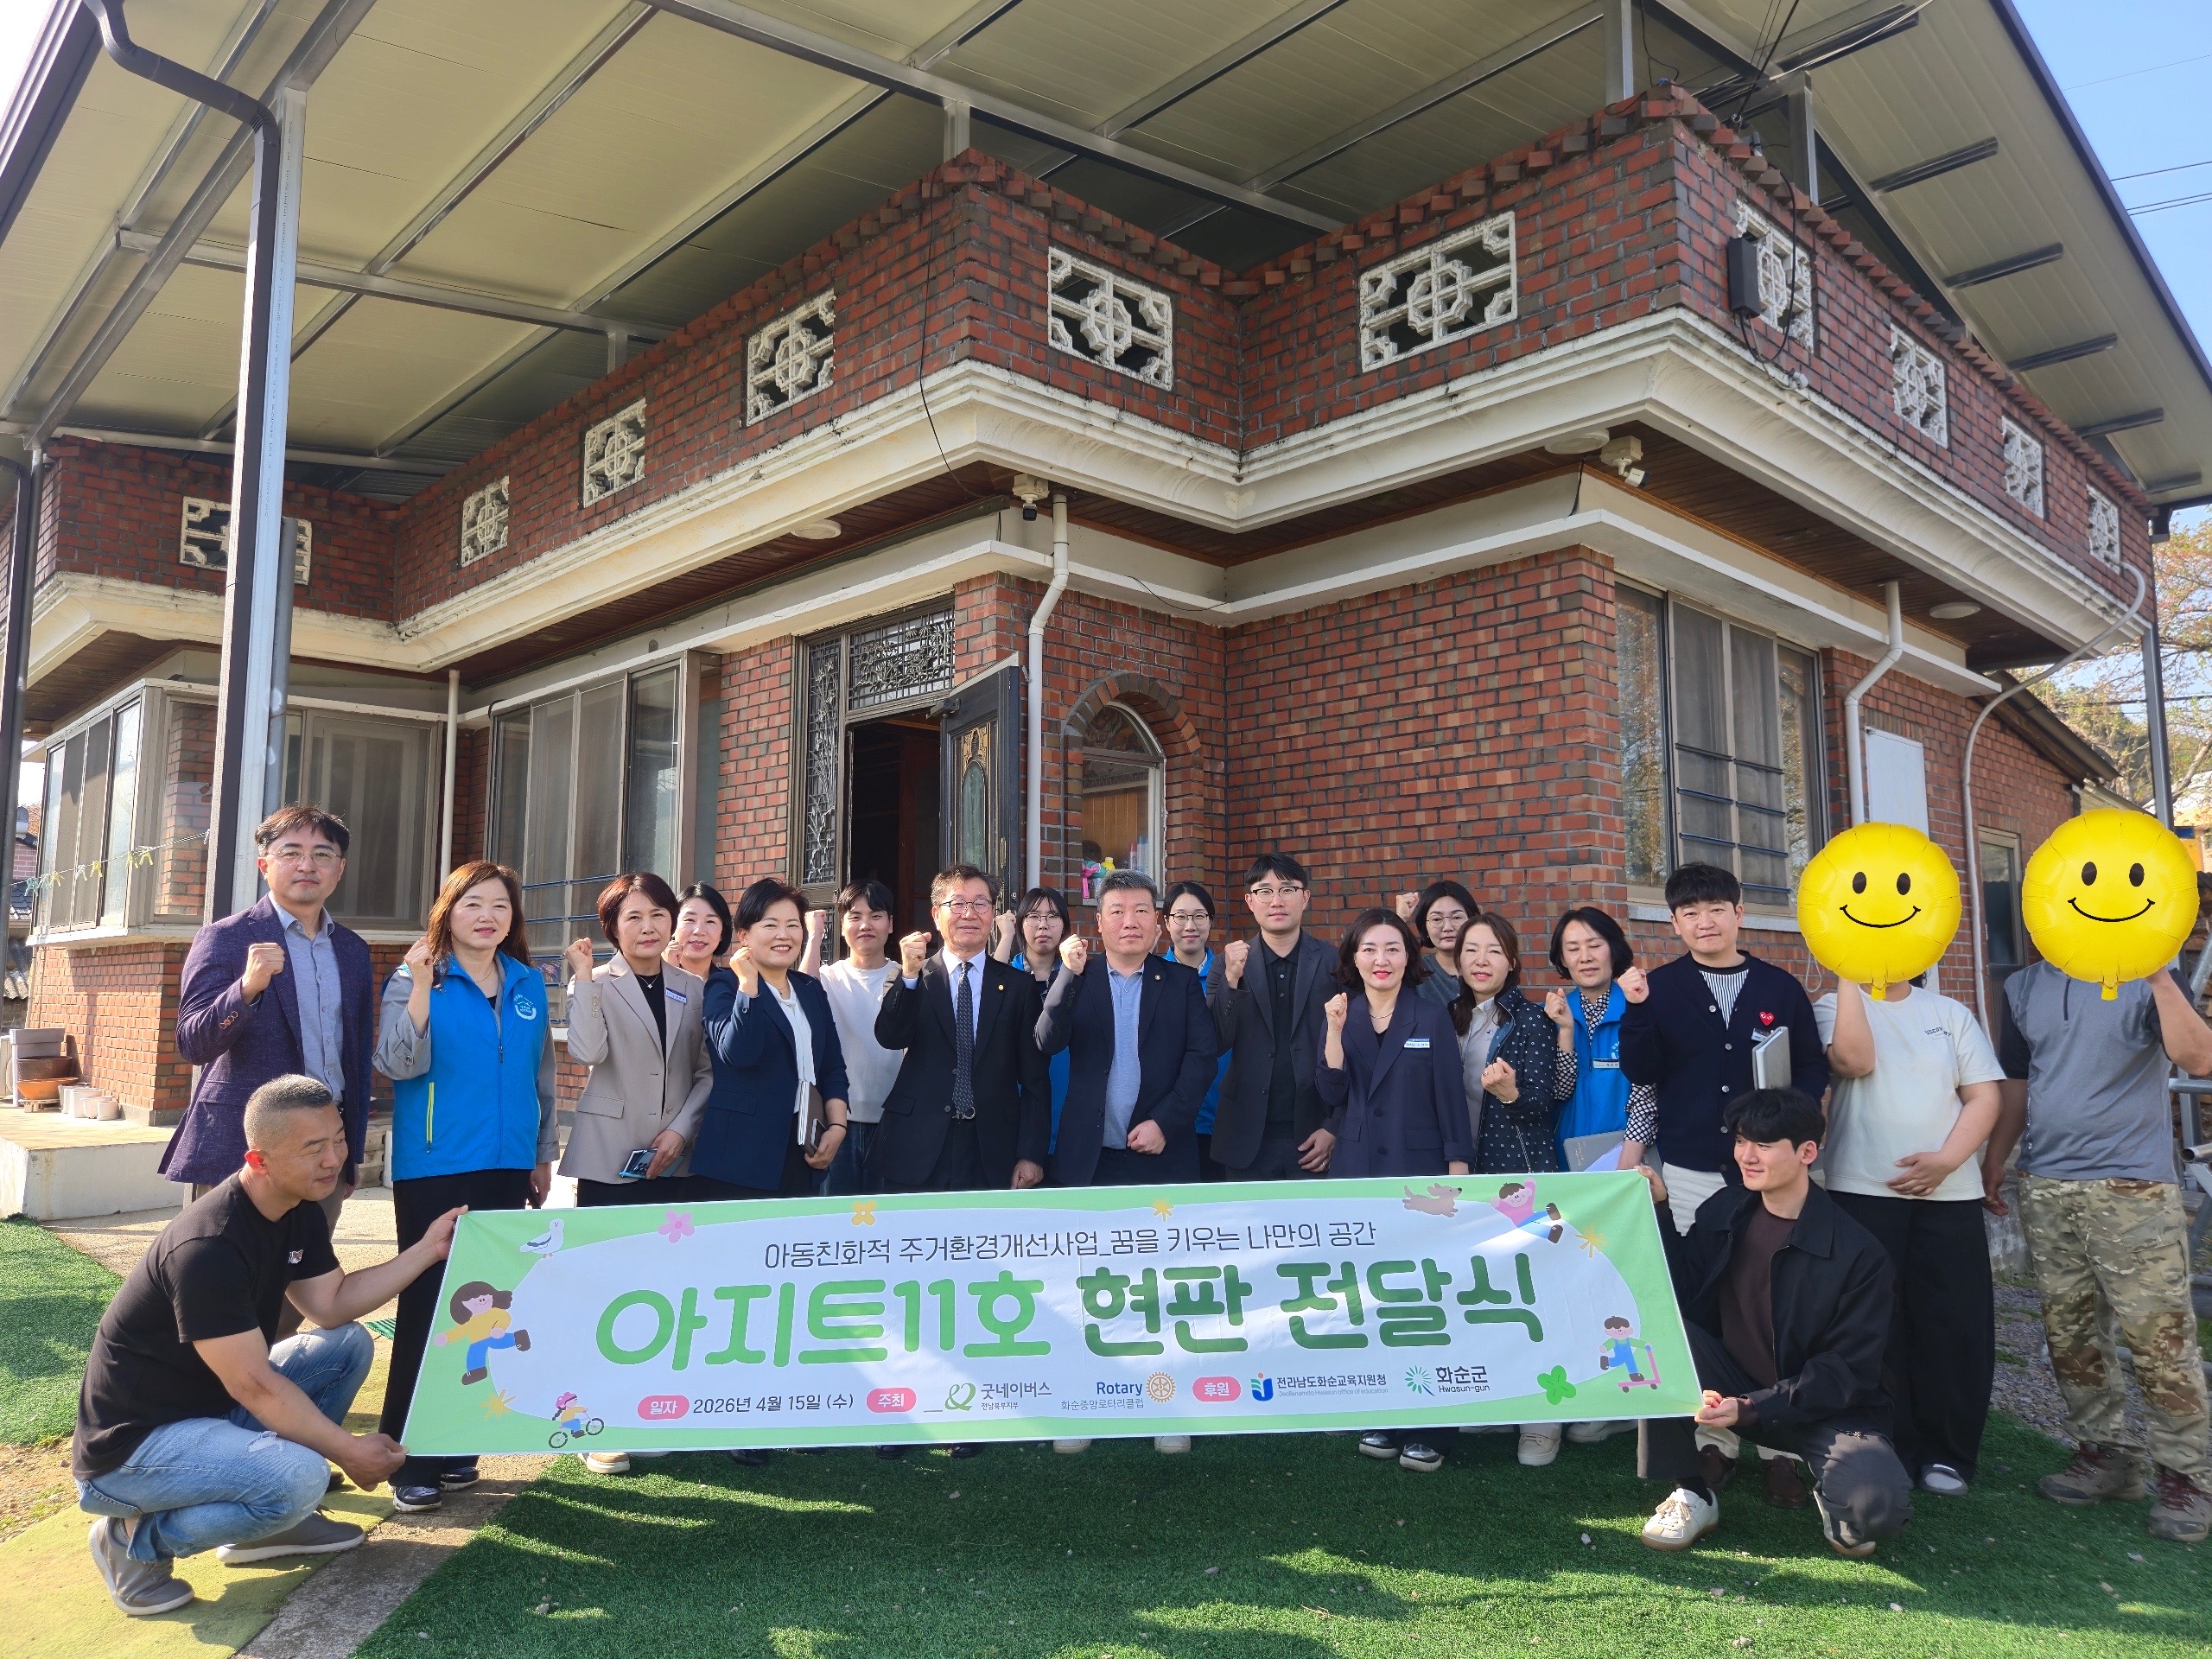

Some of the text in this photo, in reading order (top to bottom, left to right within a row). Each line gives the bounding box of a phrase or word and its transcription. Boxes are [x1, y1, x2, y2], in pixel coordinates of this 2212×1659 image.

[765, 1238, 891, 1268] 아동친화적
[1166, 1225, 1240, 1253] 키우는
[1247, 1223, 1321, 1250] 나만의
[1328, 1221, 1376, 1248] 공간
[595, 1253, 1544, 1370] 아지트11호 현판 전달식
[1276, 1373, 1388, 1389] 전라남도화순교육지원청
[1434, 1365, 1489, 1384] 화순군
[980, 1382, 1052, 1400] 굿네이버스
[1096, 1381, 1143, 1396] Rotary
[1203, 1382, 1230, 1397] 후원
[1438, 1384, 1491, 1394] Hwasun-gun
[649, 1400, 678, 1416] 일자
[692, 1393, 854, 1414] 2026년 4월 15일 (수)
[877, 1392, 906, 1408] 주최
[1061, 1397, 1144, 1411] 화순중앙로타리클럽
